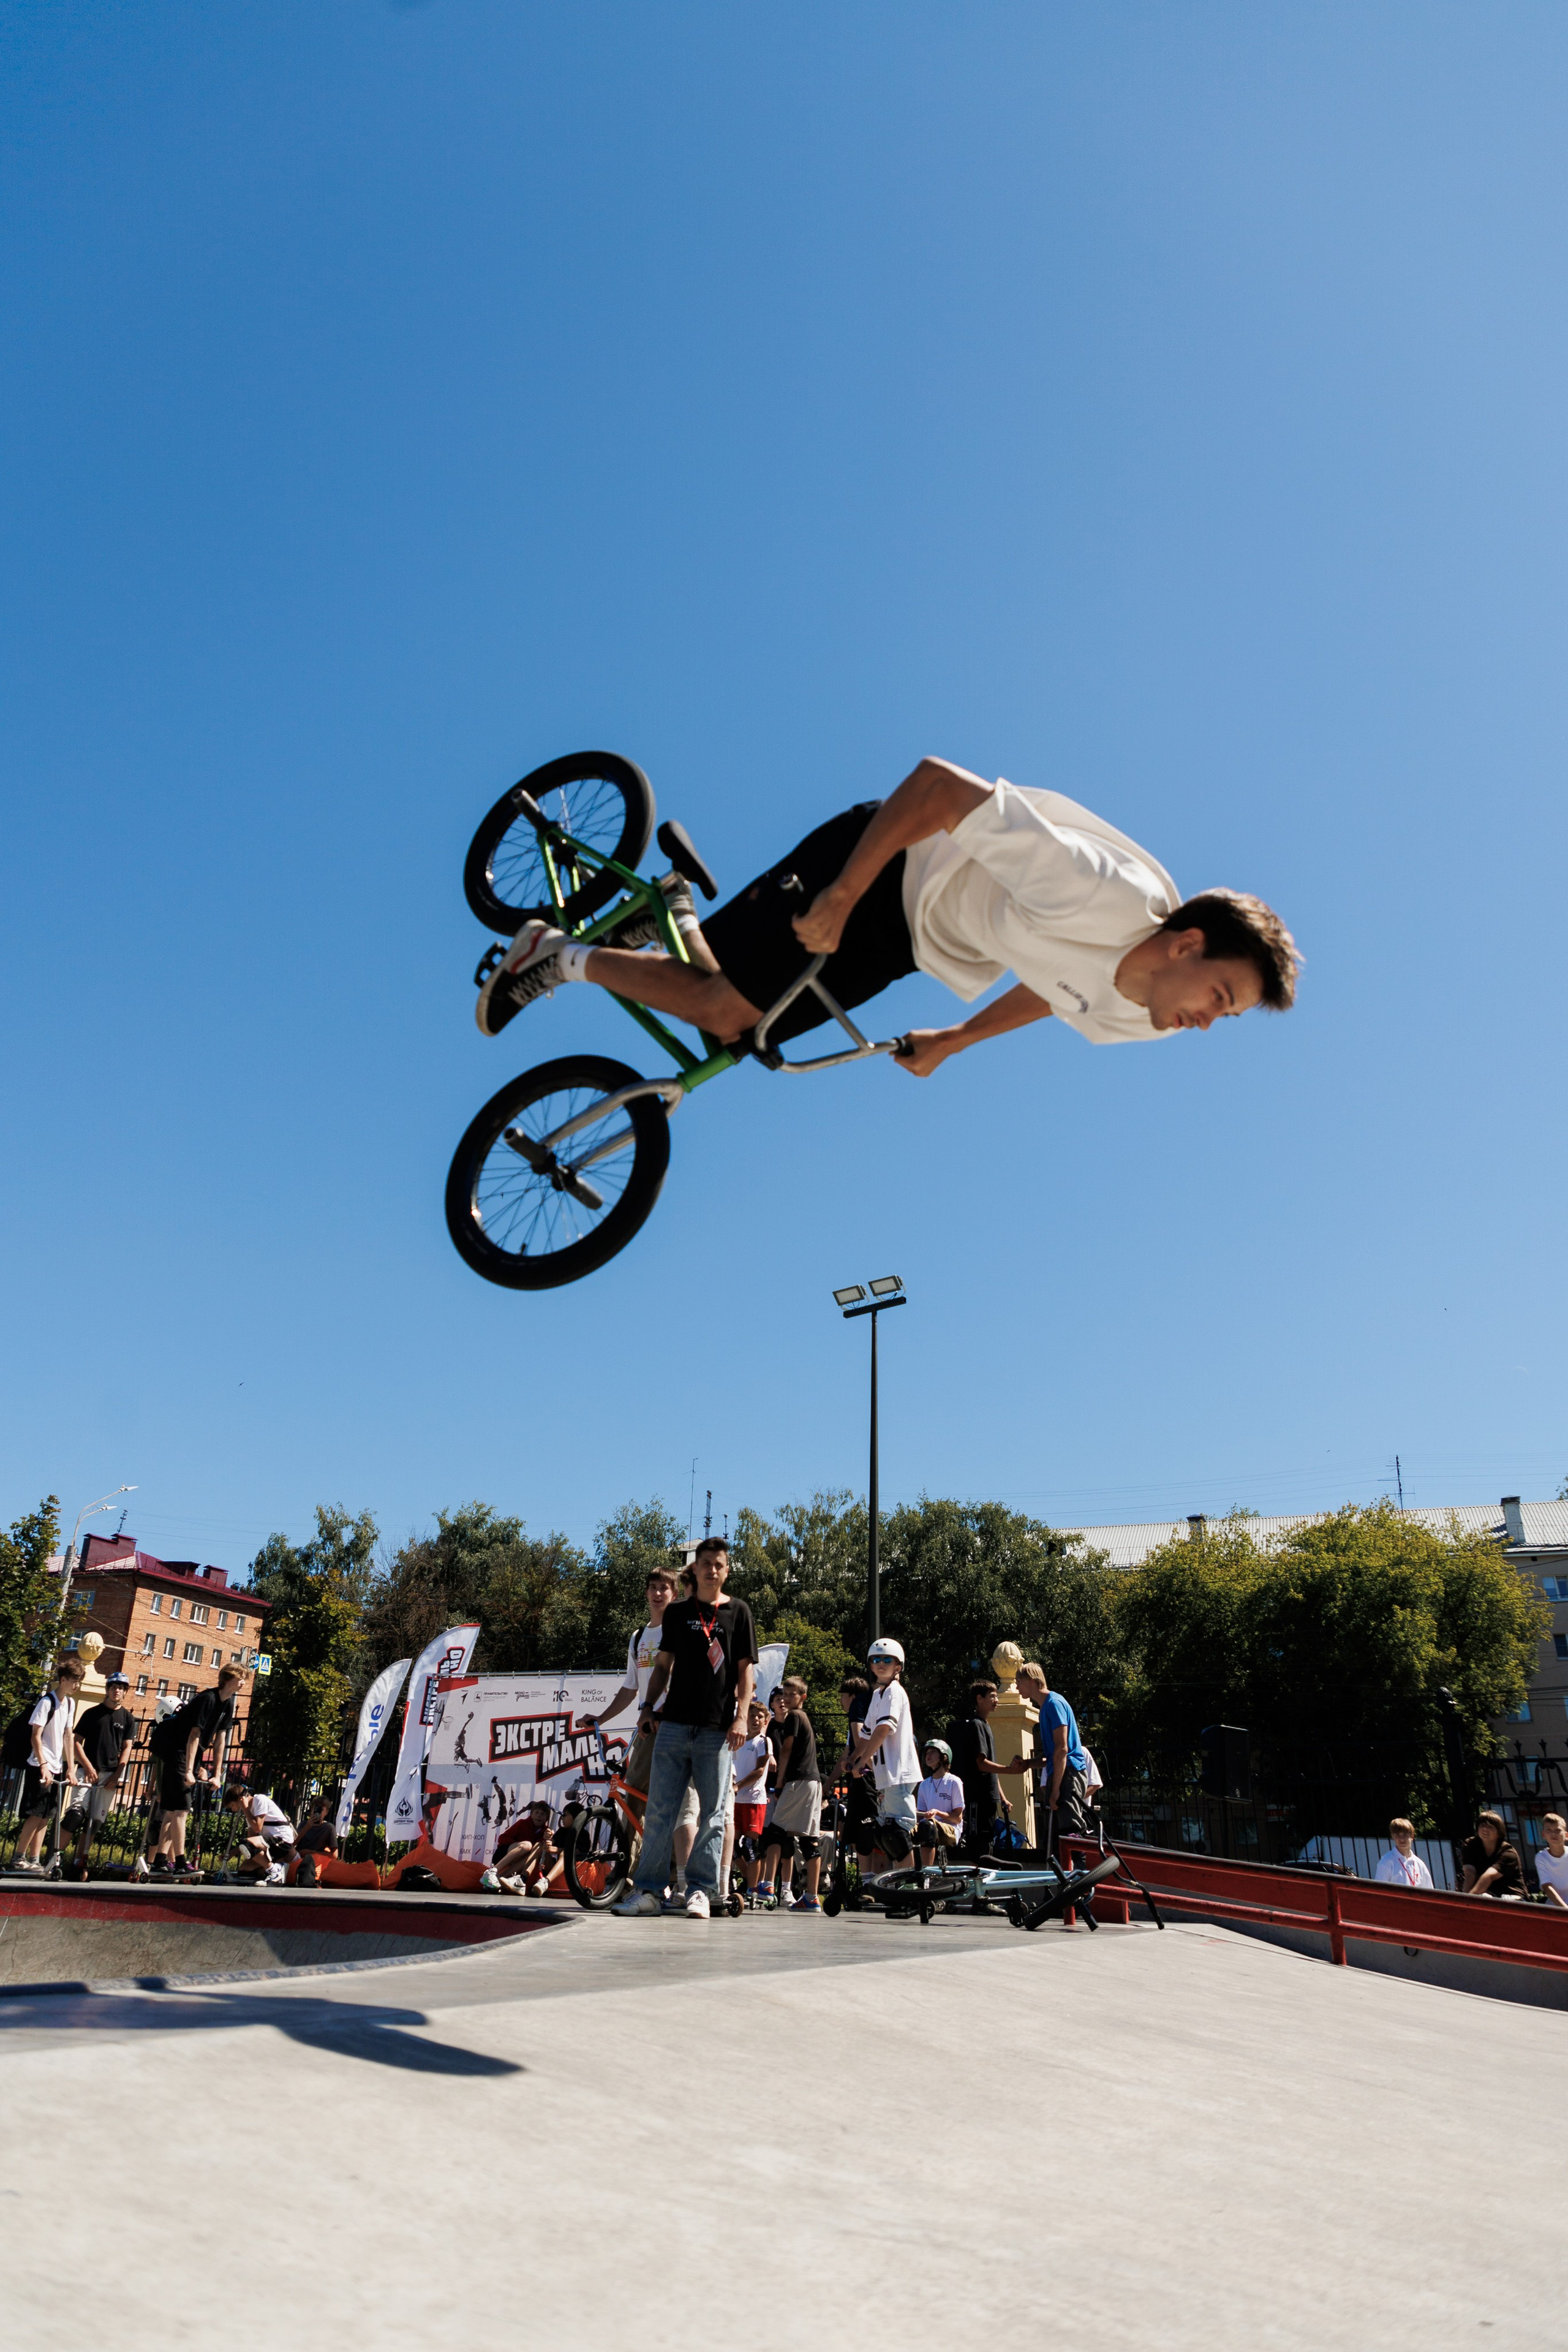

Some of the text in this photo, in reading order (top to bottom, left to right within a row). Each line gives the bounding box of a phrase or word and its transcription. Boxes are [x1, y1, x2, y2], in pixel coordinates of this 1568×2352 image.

[450, 1649, 462, 1669] НО
[495, 1719, 566, 1754] ЭКСТРЕ
[542, 1734, 603, 1773] МАЛЬ
